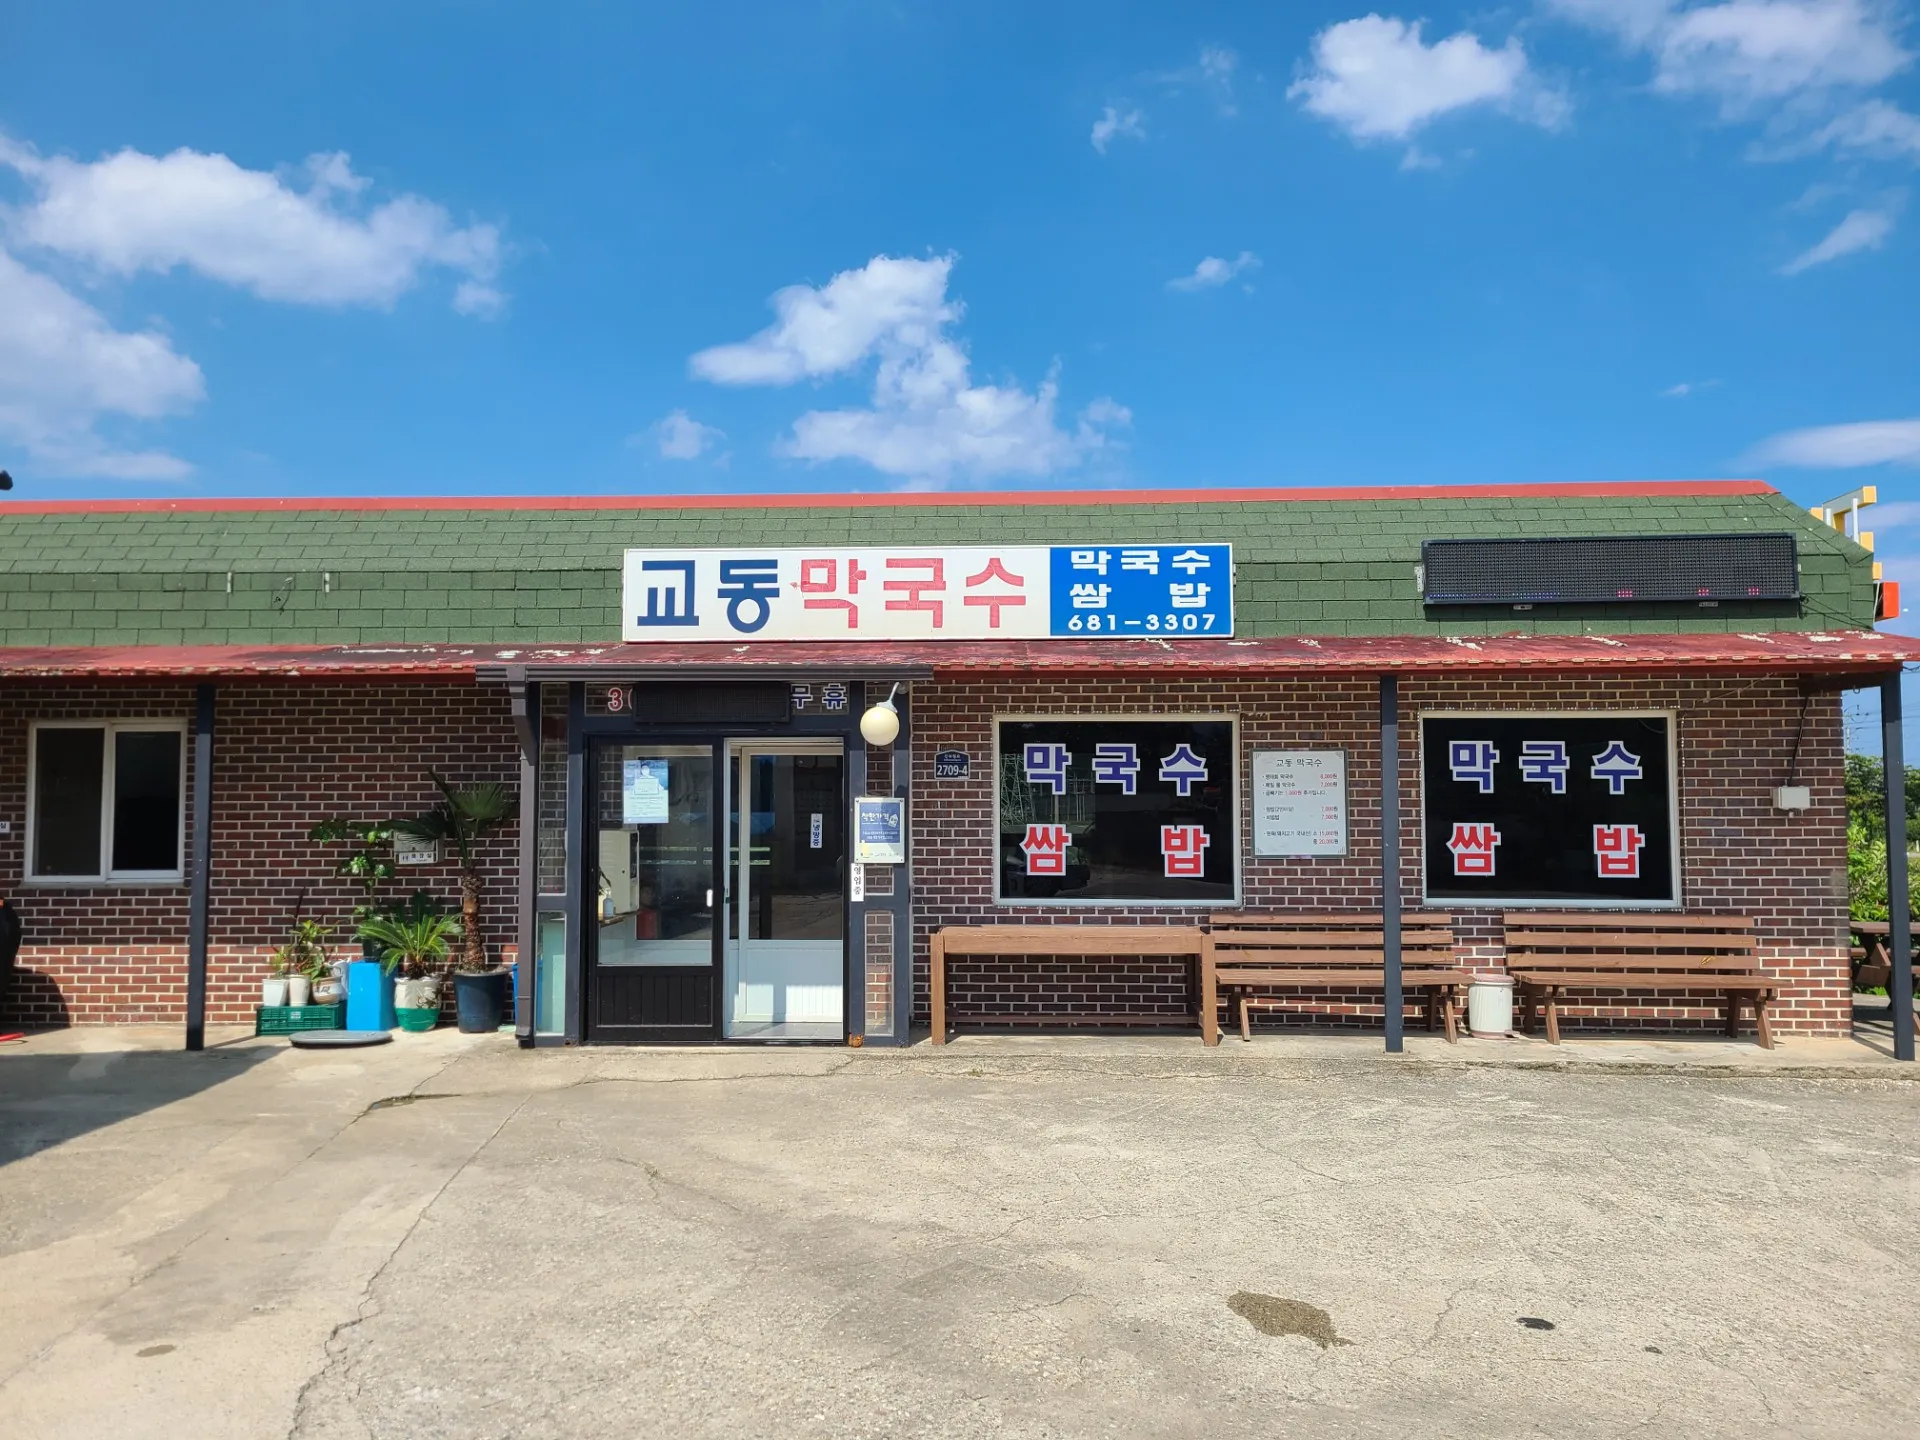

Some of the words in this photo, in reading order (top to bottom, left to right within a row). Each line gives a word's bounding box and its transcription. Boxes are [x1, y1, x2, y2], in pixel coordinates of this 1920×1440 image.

[1069, 547, 1213, 576] 막국수
[1068, 614, 1216, 632] 681-3307
[936, 764, 968, 776] 2709-4
[1024, 743, 1208, 796] 막국수
[1296, 758, 1323, 767] 막국수
[1449, 740, 1643, 794] 막국수
